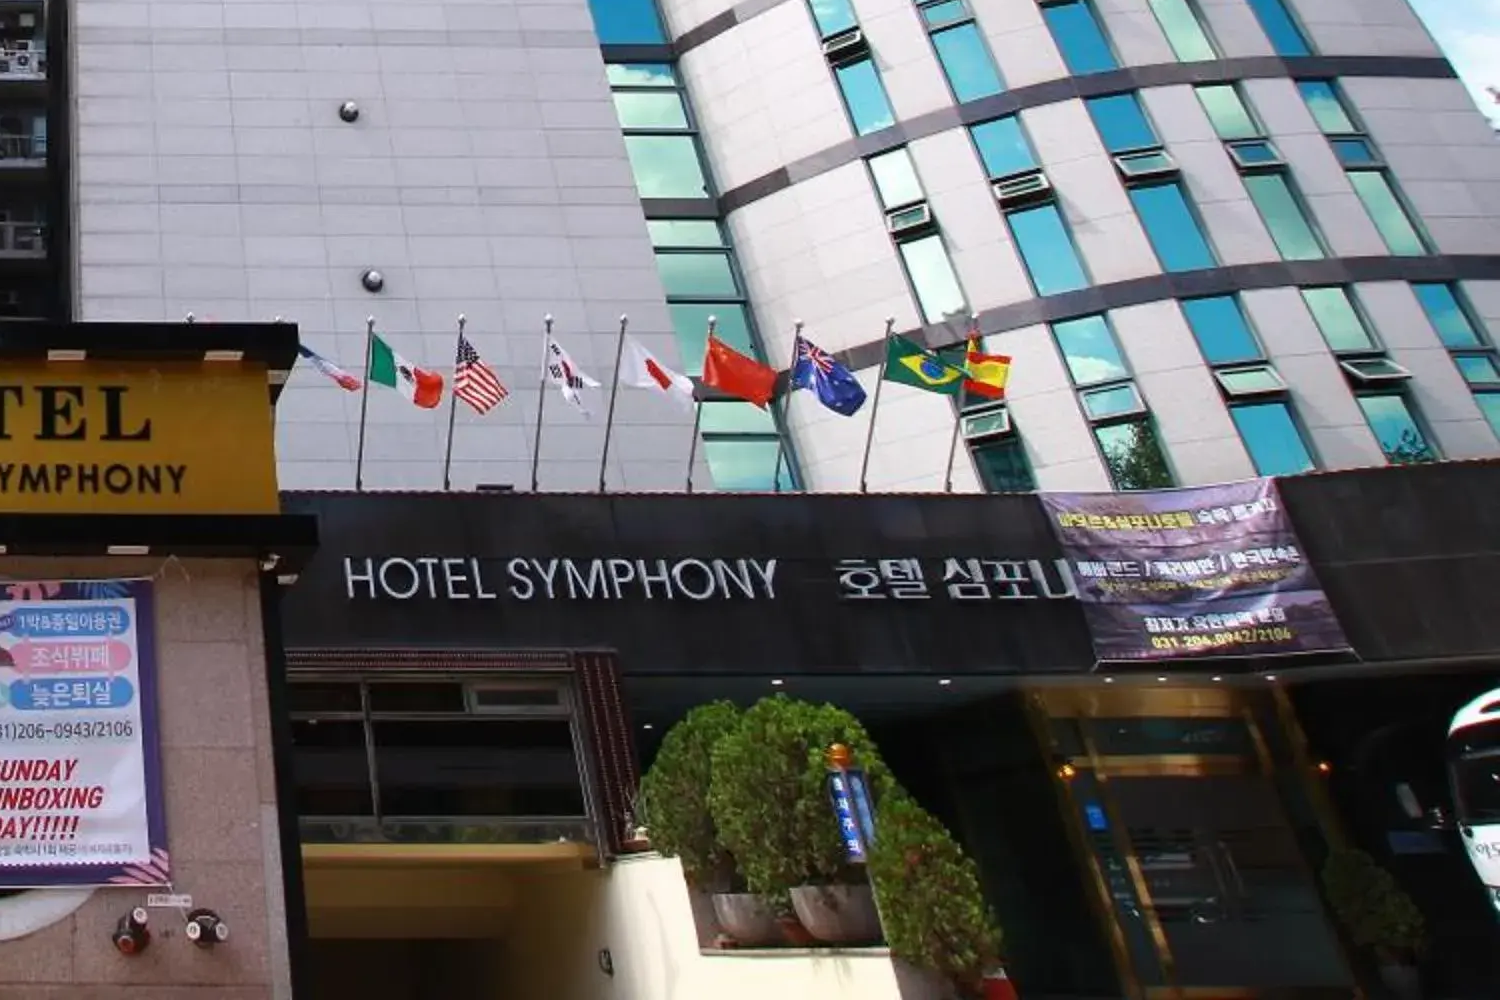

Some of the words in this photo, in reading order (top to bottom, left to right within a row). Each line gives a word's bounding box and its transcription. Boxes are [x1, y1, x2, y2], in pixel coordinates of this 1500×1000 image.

[343, 557, 497, 600] HOTEL
[506, 557, 777, 600] SYMPHONY
[833, 556, 932, 600] 호텔
[942, 558, 1081, 600] 심포니
[31, 644, 110, 669] 조식뷔페
[31, 680, 112, 707] 늦은퇴실
